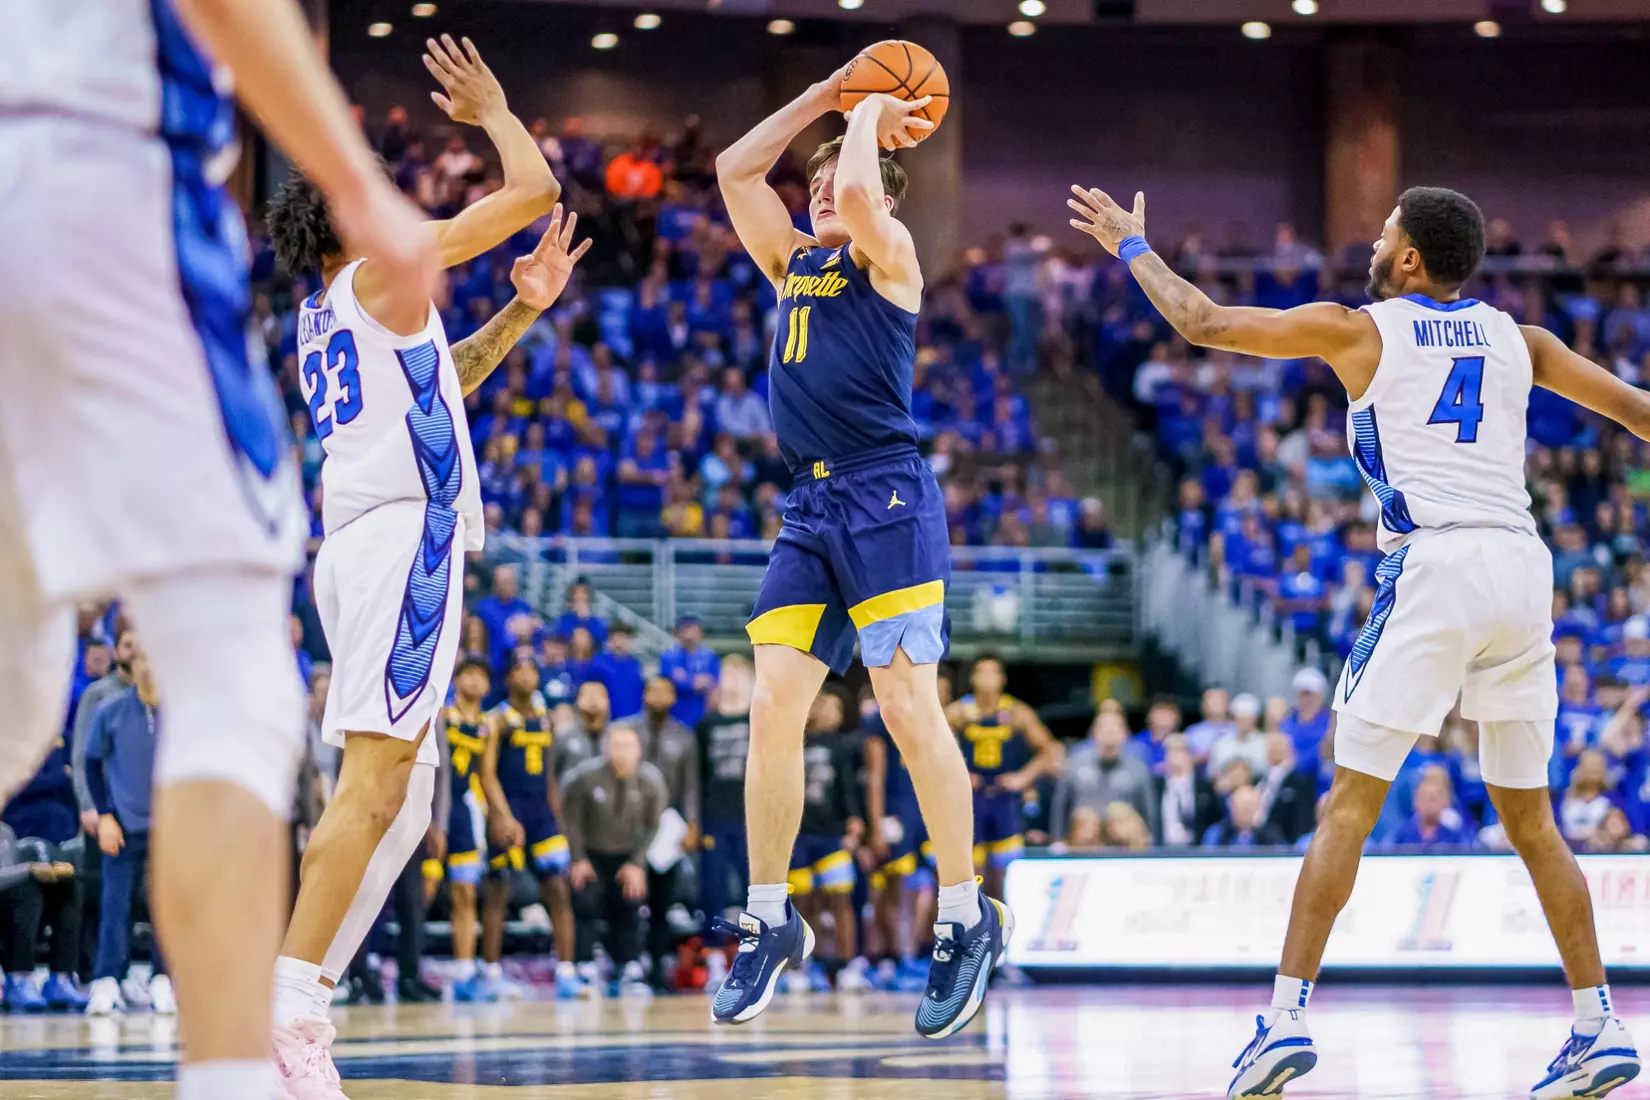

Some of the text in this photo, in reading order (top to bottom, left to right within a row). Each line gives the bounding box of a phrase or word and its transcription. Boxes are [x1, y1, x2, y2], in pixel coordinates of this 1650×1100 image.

[782, 271, 848, 302] Mrquette
[783, 306, 811, 364] 11
[1413, 320, 1491, 347] MITCHELL
[303, 328, 364, 440] 23
[1425, 356, 1486, 443] 4
